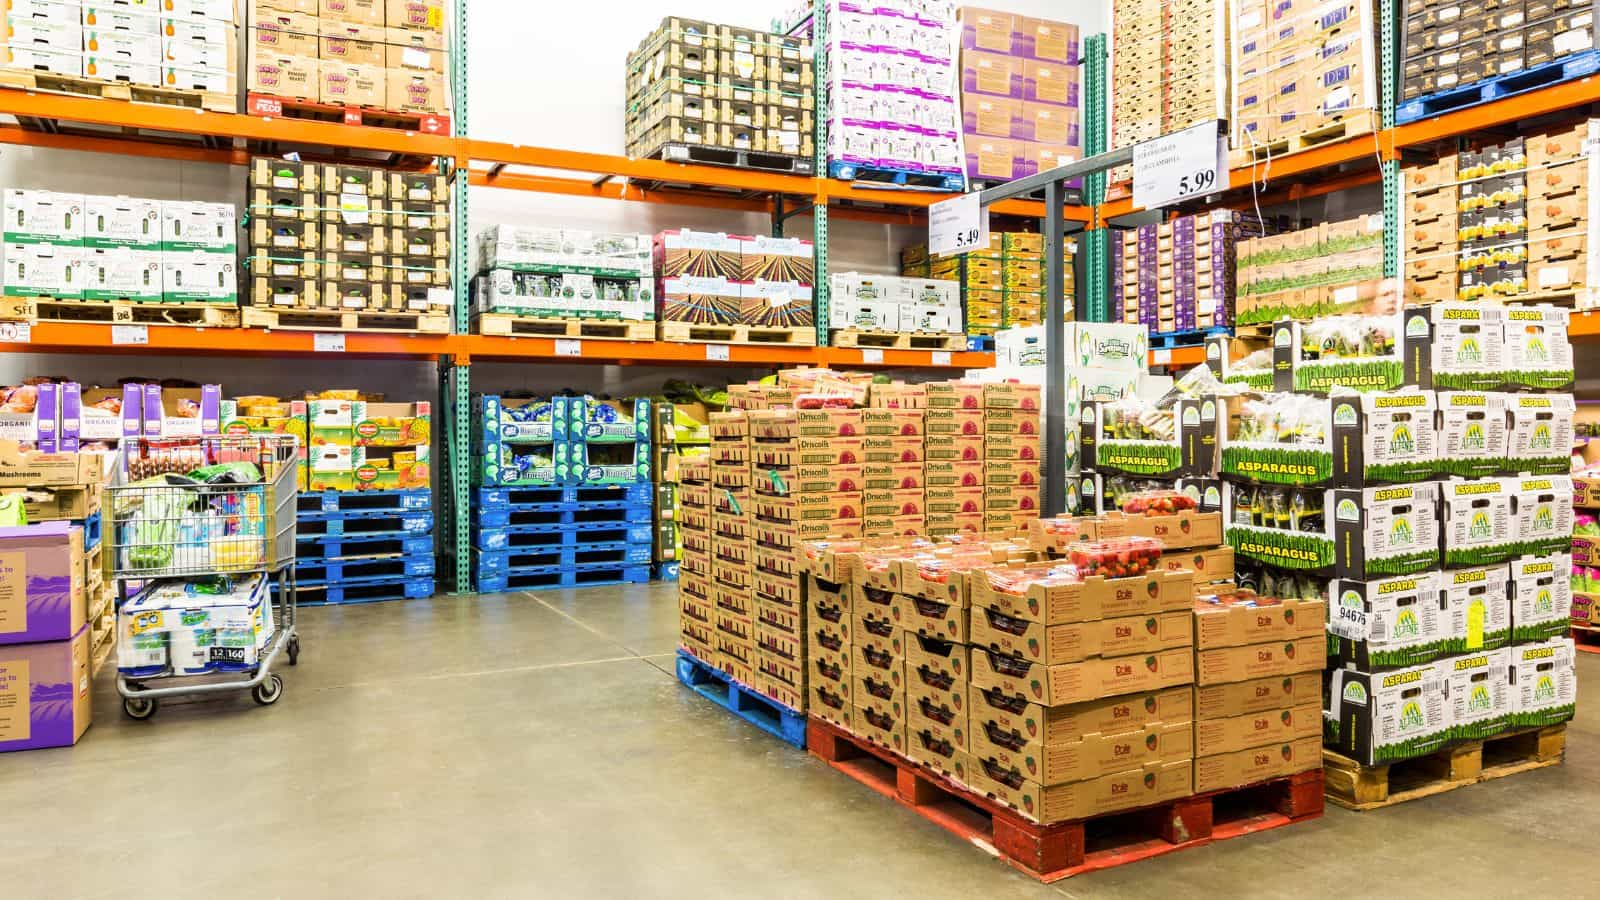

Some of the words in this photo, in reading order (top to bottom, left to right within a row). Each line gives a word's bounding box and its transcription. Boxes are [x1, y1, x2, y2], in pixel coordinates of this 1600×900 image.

[1179, 170, 1214, 195] 5.99
[957, 229, 979, 247] 5.49
[1109, 456, 1168, 466] ASPARAGUS
[1237, 461, 1316, 476] ASPARAGUS
[1154, 526, 1168, 535] Dole
[1240, 542, 1318, 561] ASPARAGUS
[1116, 590, 1132, 600] Dole
[1258, 616, 1272, 626] Dole
[1116, 627, 1132, 637] Dole
[228, 650, 244, 658] 160
[1258, 651, 1272, 661] Dole
[1116, 666, 1132, 676] Dole
[1256, 686, 1270, 697] Dole
[1113, 706, 1129, 718] Dole
[1254, 719, 1268, 730] Dole
[1114, 744, 1130, 755] Dole
[1255, 754, 1269, 765] Dole
[1112, 783, 1128, 793] Dole
